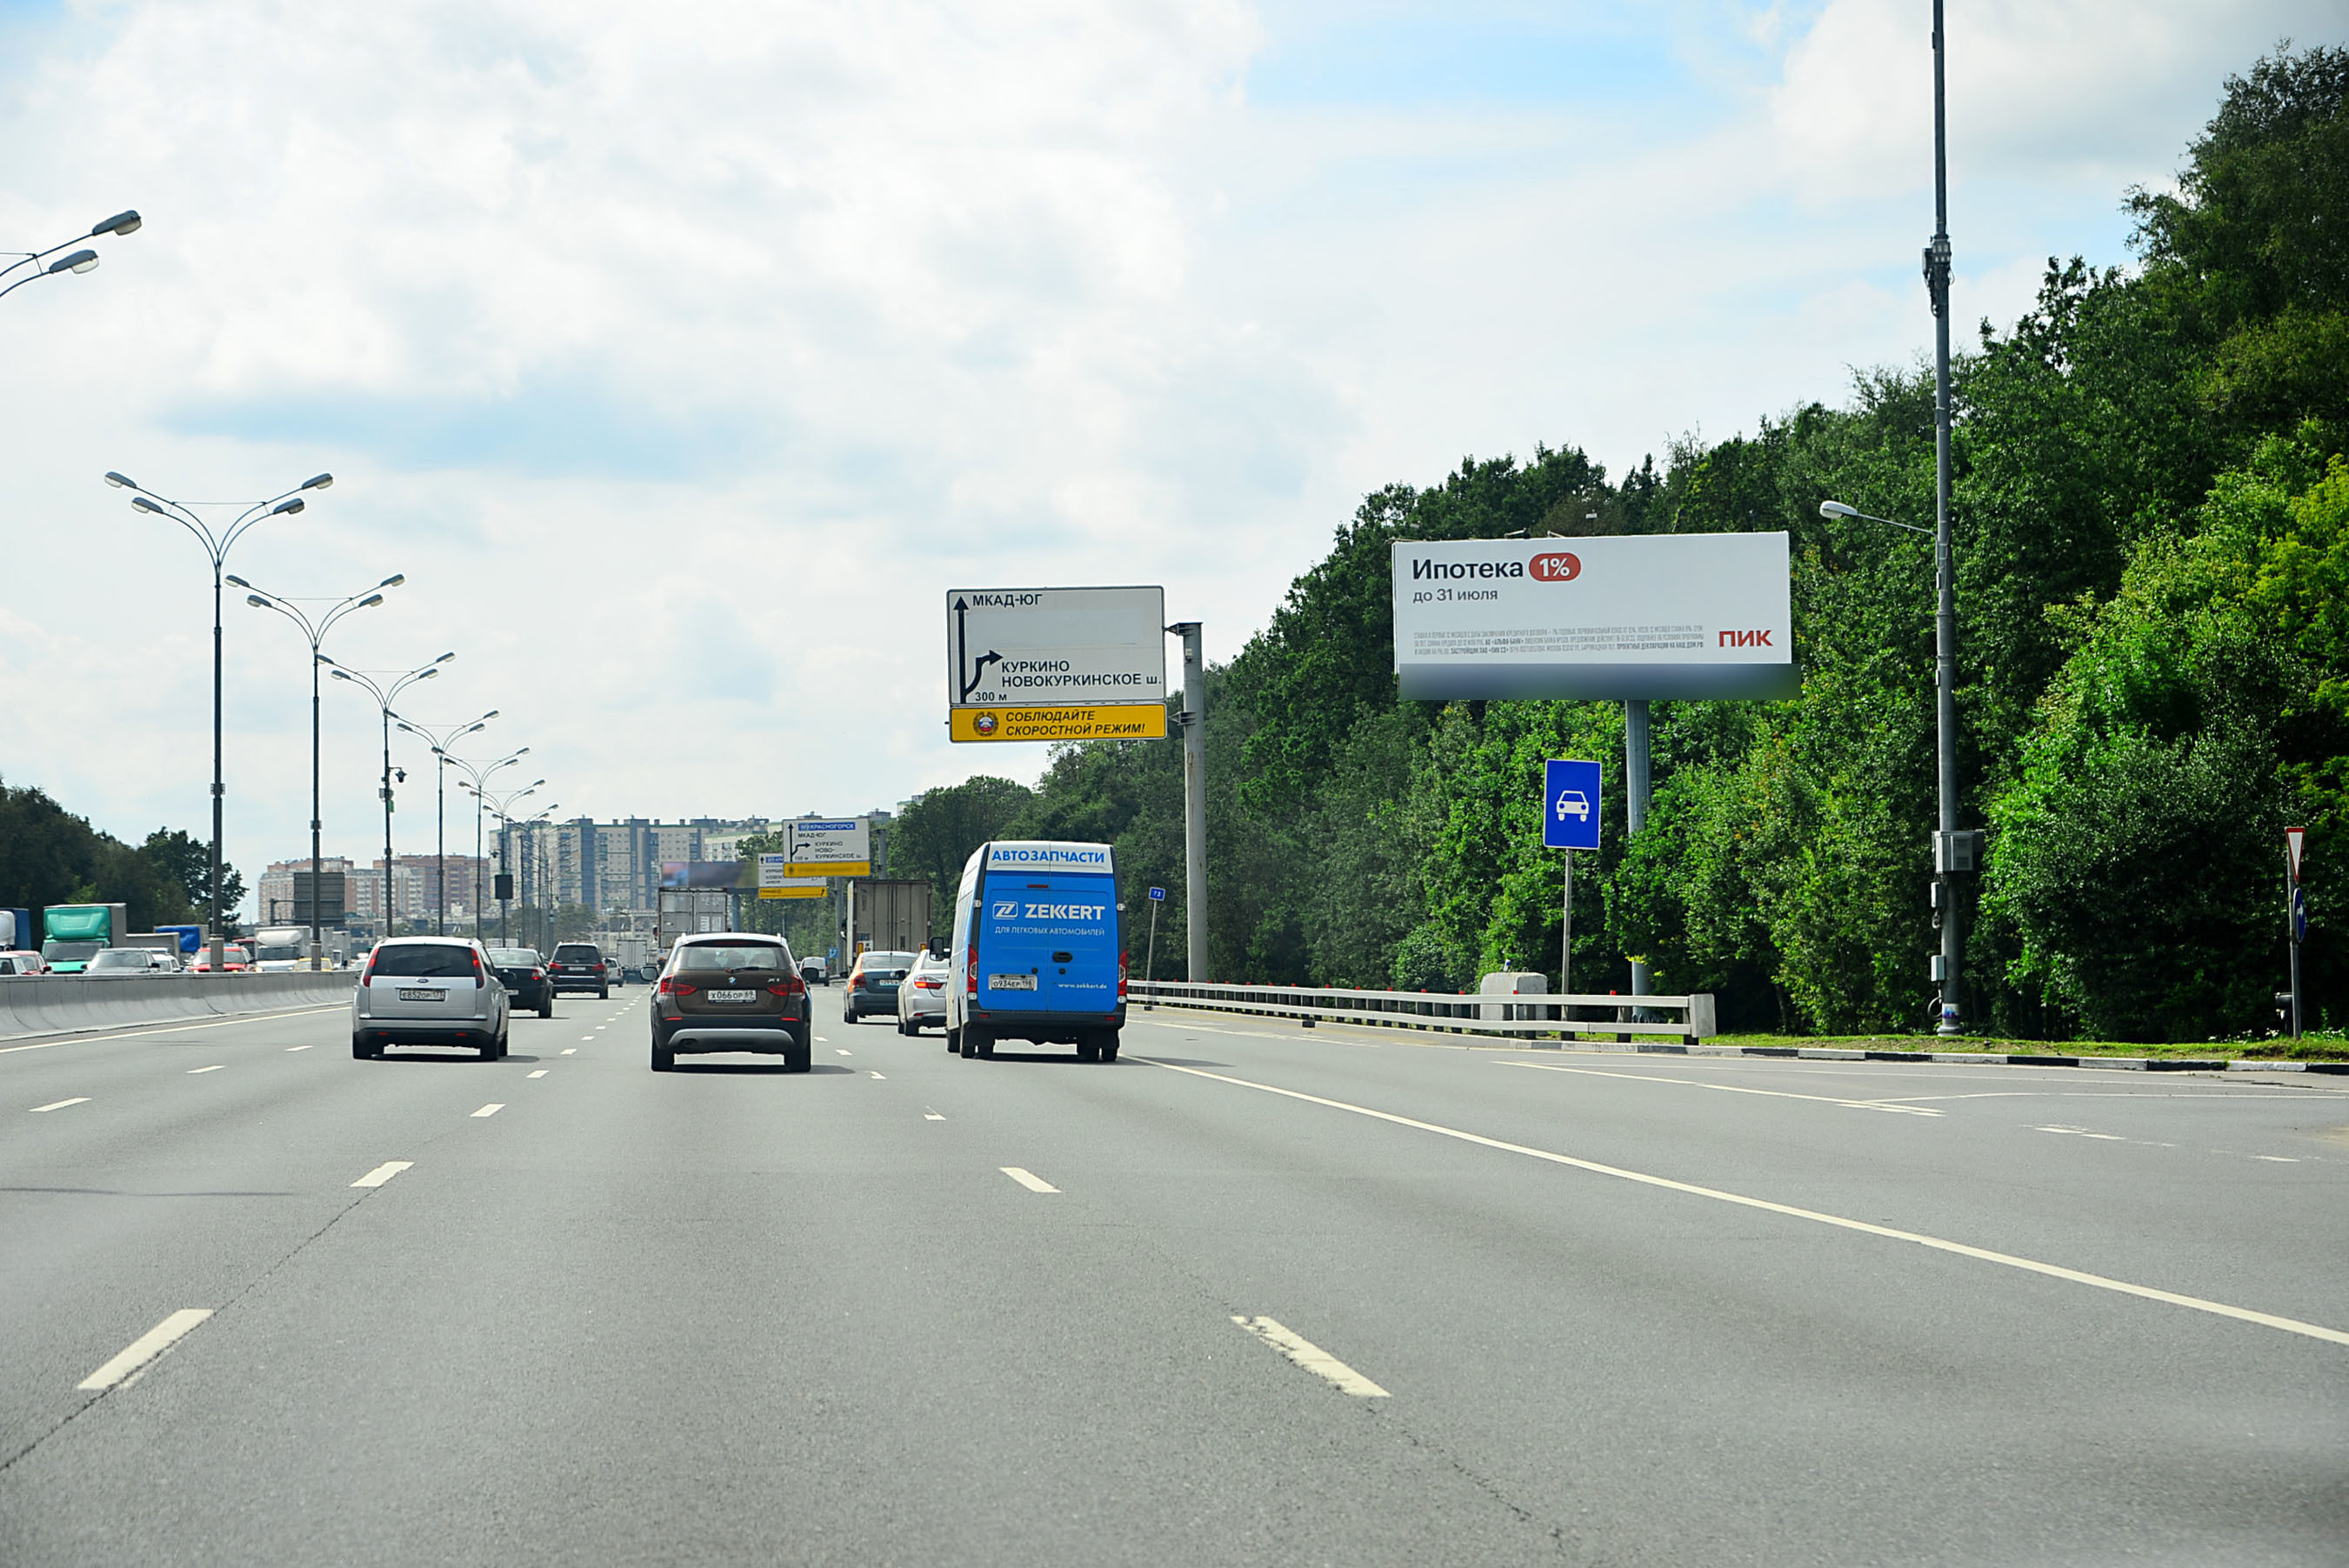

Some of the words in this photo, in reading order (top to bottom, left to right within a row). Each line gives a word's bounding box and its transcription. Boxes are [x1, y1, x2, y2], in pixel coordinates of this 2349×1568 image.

[1412, 558, 1524, 580] Ипотека
[1539, 557, 1570, 577] 1%
[972, 594, 1043, 607] МКАД-ЮГ
[1412, 590, 1432, 604] до
[1436, 589, 1452, 601] 31
[1458, 588, 1498, 602] июля
[1718, 630, 1773, 648] ПИК
[1001, 661, 1070, 672] КУРКИНО
[1002, 673, 1142, 687] НОВОКУРКИНСКОЕ
[1146, 675, 1161, 684] ш.
[975, 692, 995, 702] 300
[1005, 710, 1095, 723] СОБЛЮДАЙТЕ
[1006, 724, 1091, 736] СКОРОСТНОЙ
[1094, 723, 1145, 735] РЕЖИМ!
[991, 851, 1105, 863] АВТОЗАПЧАСТИ
[995, 926, 1011, 935] ДЛЯ
[1049, 927, 1105, 936] АВТОМОБИЛЕЙ
